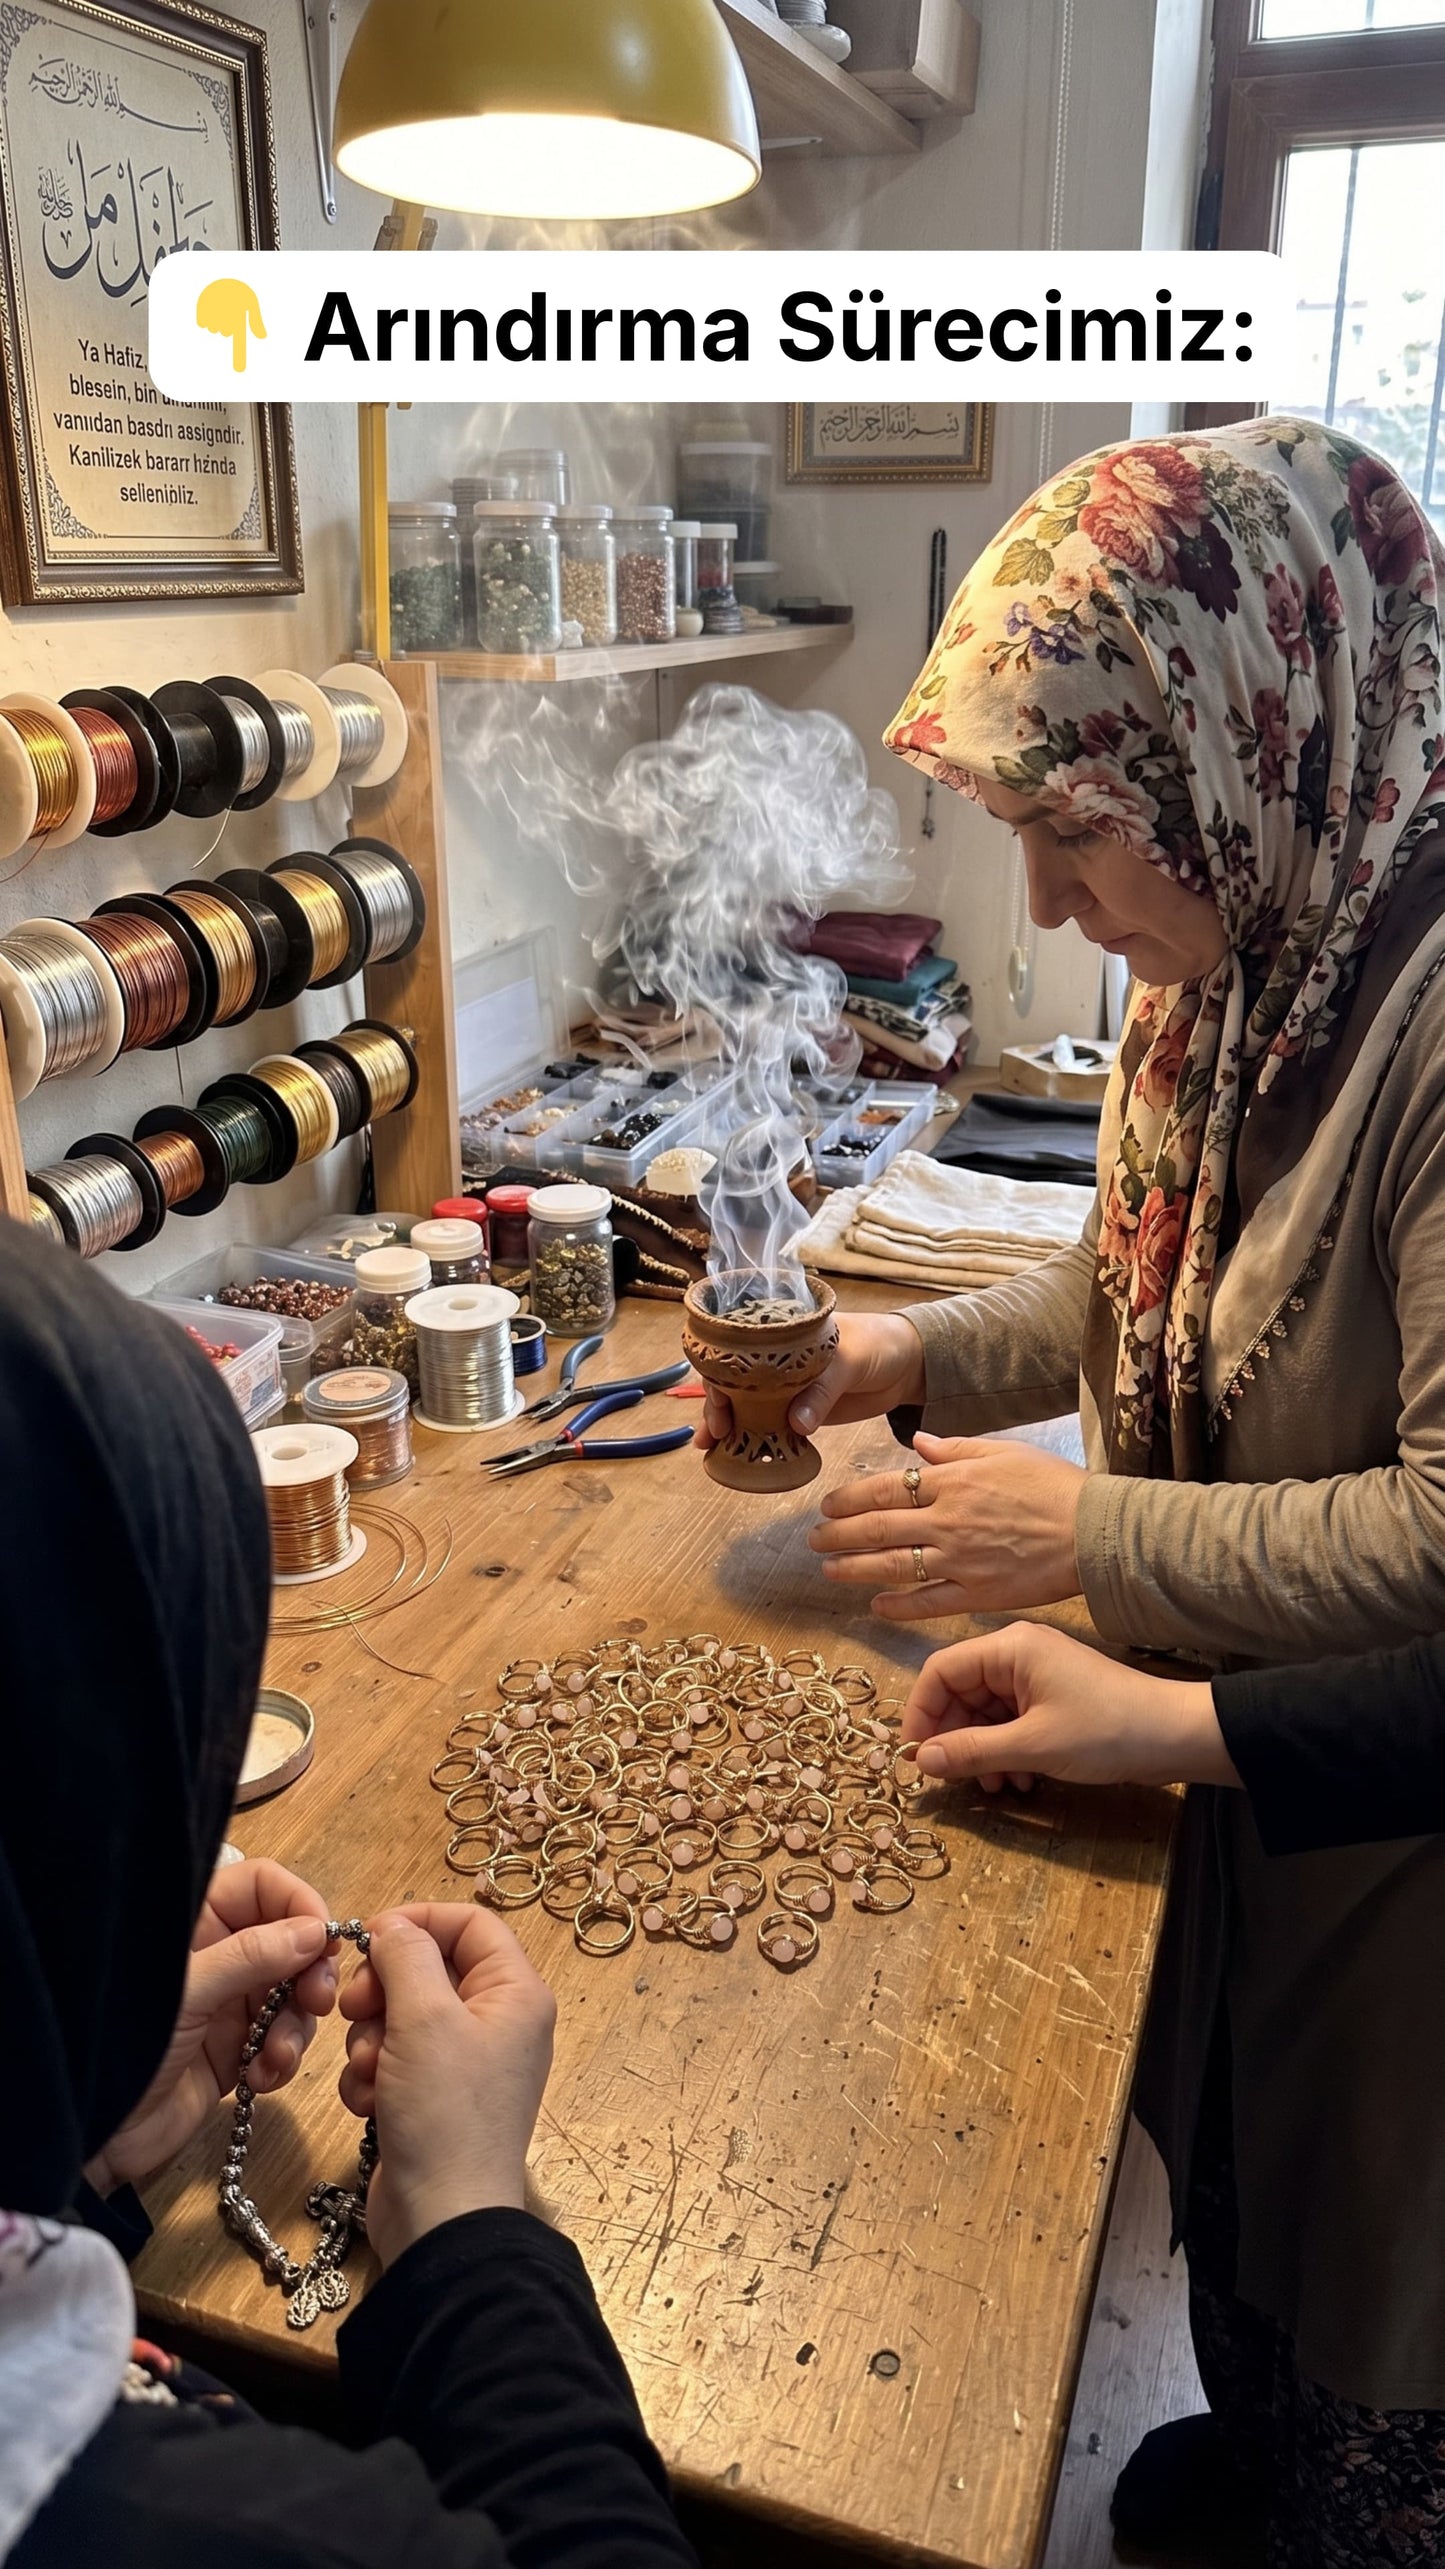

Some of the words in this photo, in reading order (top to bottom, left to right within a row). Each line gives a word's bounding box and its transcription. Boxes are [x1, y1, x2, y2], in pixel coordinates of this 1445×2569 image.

[78, 338, 99, 363] Ya
[104, 342, 148, 373] Hafiz,
[69, 373, 131, 405] blesein,
[134, 381, 158, 405] bin
[69, 443, 142, 470] Kanilizek
